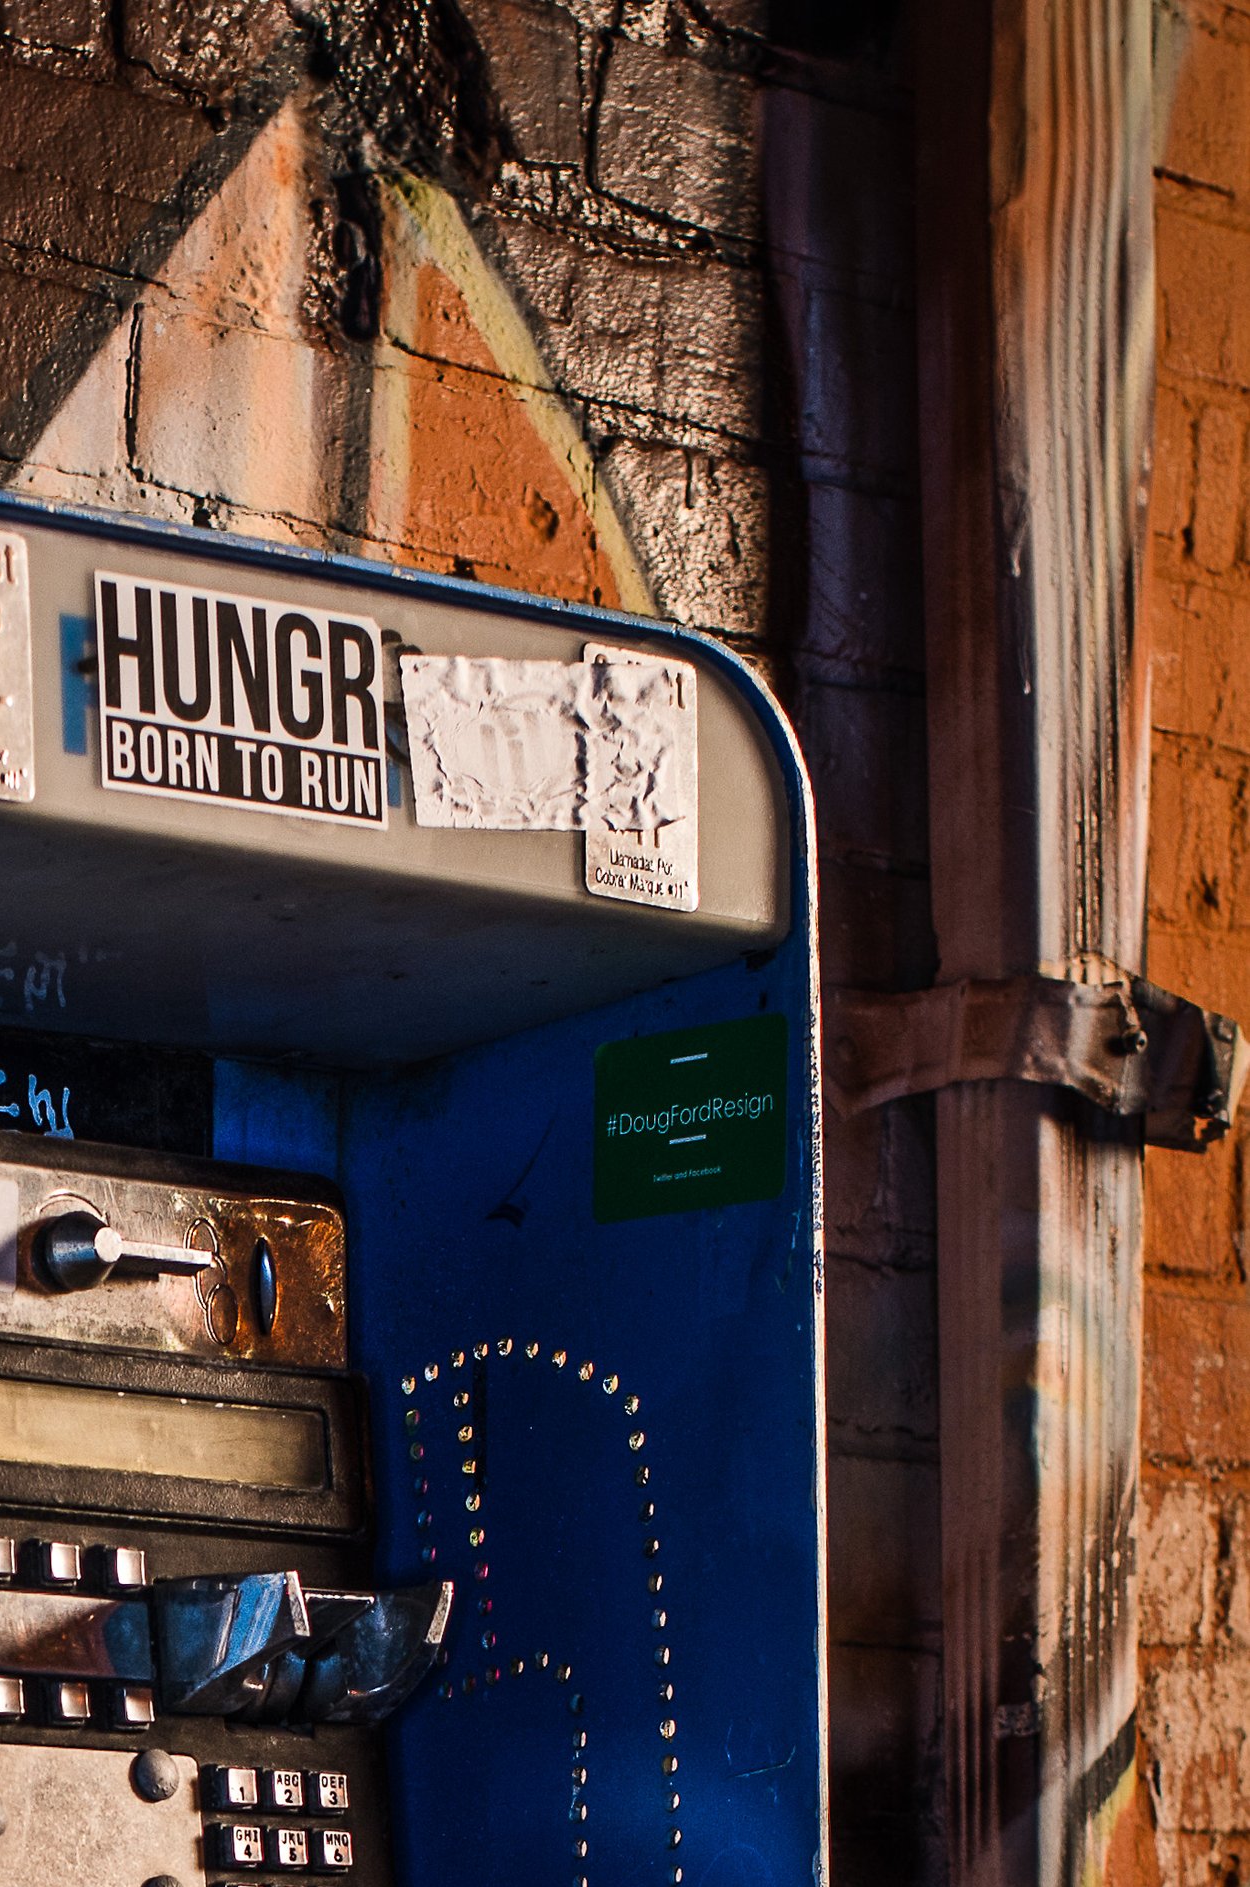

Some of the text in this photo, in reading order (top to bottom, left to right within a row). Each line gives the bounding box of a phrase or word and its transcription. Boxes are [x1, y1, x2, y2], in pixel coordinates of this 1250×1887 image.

[100, 581, 380, 751] HUNGR
[112, 720, 377, 816] BORN TO RUN
[606, 1092, 774, 1138] #DougFordResign
[277, 1774, 299, 1787] ABC
[321, 1775, 345, 1788] DEF
[238, 1787, 246, 1801] 1
[284, 1789, 293, 1803] 2
[329, 1791, 338, 1804] 3
[236, 1829, 259, 1843] GHI
[281, 1832, 304, 1845] JKL
[326, 1833, 349, 1847] MNO
[243, 1845, 252, 1859] 4
[288, 1848, 297, 1862] 5
[333, 1848, 343, 1863] 6
